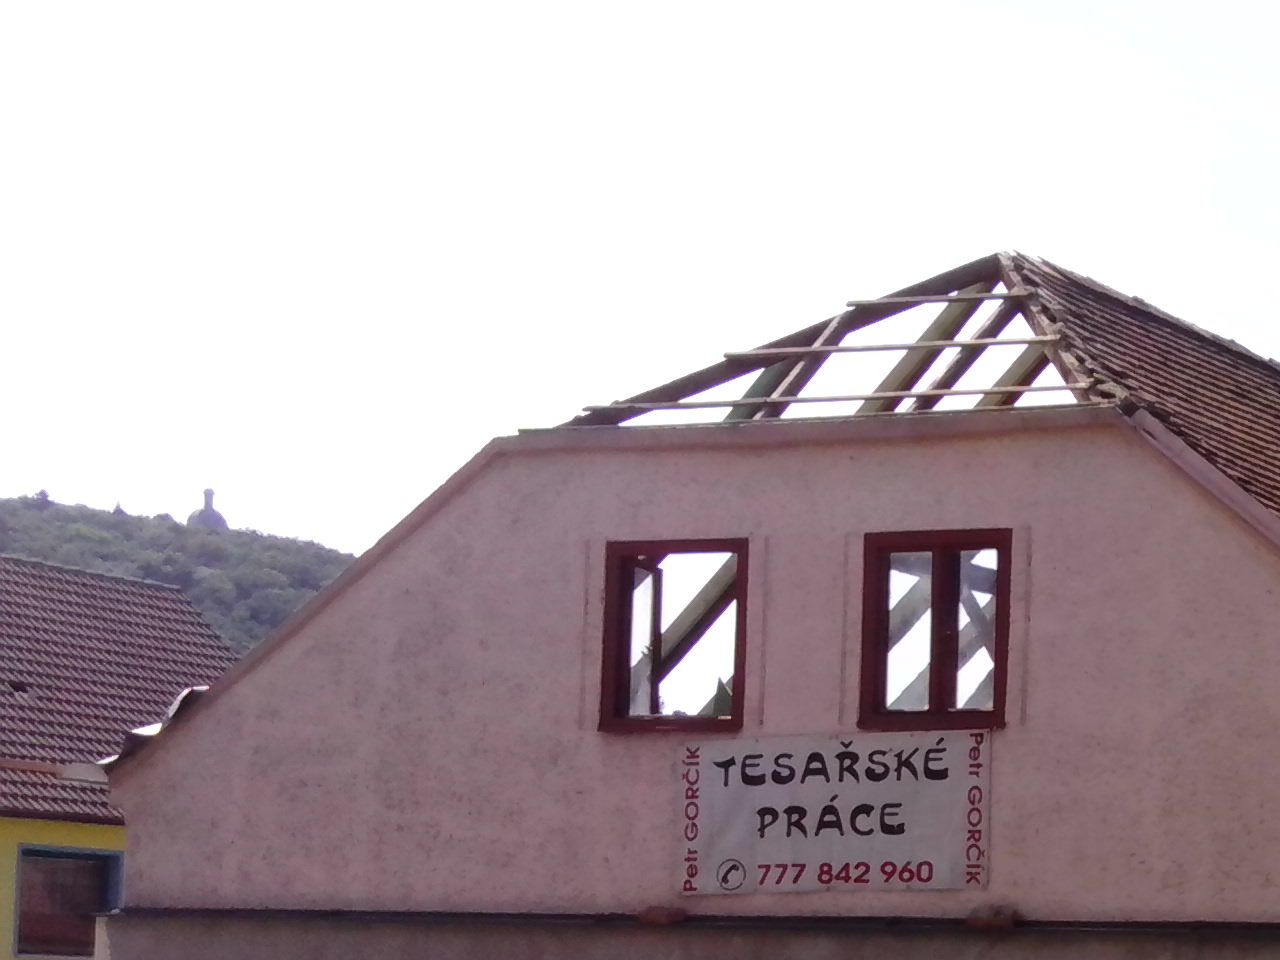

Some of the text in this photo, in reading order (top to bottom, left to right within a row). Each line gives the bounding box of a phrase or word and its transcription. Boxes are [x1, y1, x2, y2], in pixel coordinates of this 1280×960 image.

[713, 737, 949, 787] TESAŘSKÉ
[682, 746, 700, 892] Petr GORČÍK
[756, 794, 905, 838] PRÁCE
[966, 732, 985, 885] Petr GORČÍK
[757, 860, 933, 885] 777 842 960
